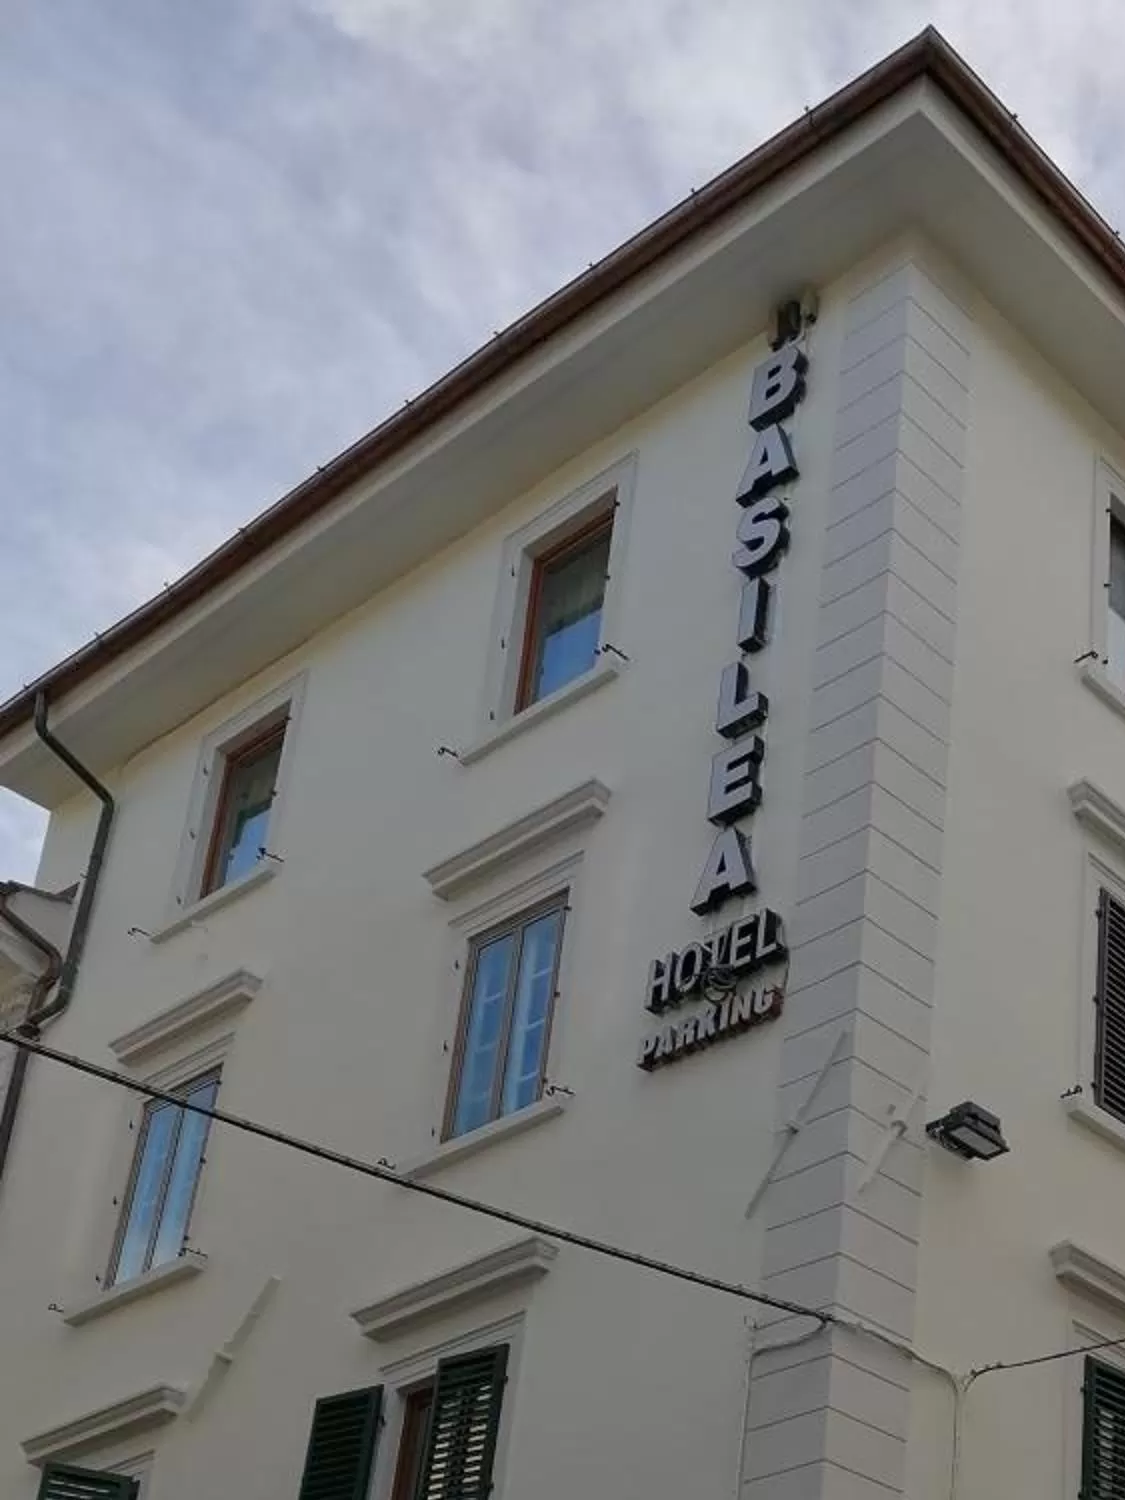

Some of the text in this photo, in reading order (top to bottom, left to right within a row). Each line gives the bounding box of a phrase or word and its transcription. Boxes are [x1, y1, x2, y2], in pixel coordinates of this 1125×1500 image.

[691, 344, 807, 916] BASILEA
[644, 907, 784, 1010] HOTEL
[636, 983, 783, 1071] PARKING
